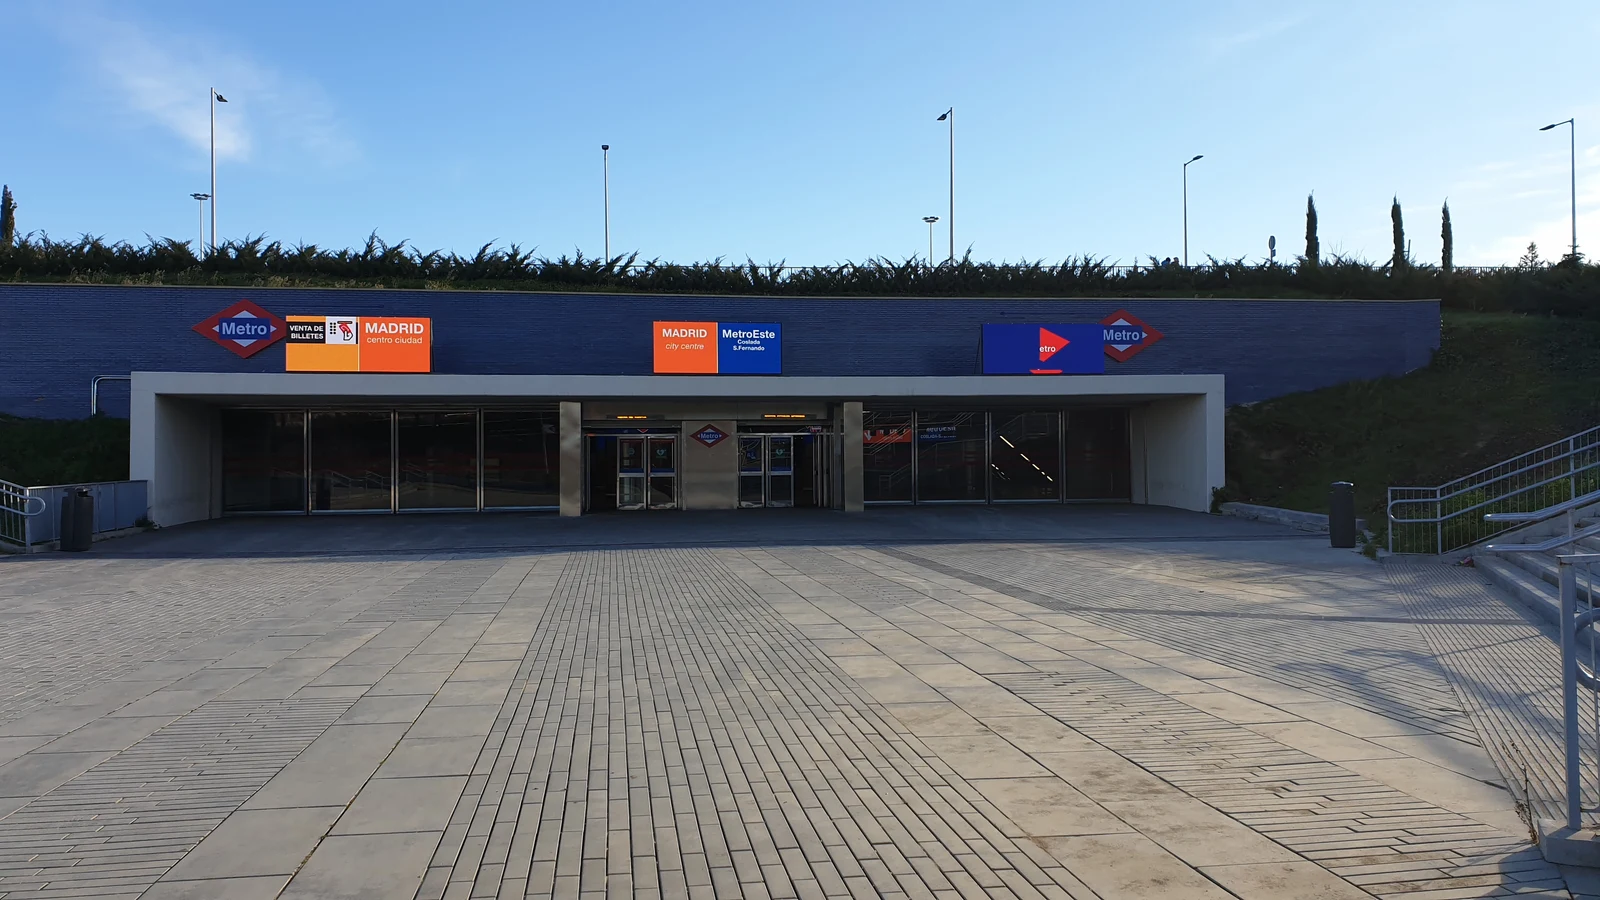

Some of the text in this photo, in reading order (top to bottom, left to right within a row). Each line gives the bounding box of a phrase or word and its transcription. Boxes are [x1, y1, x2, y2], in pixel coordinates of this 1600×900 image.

[222, 321, 267, 335] Metro
[365, 322, 424, 334] MADRID
[662, 328, 708, 338] MADRID
[722, 329, 775, 339] MetroEste
[1103, 329, 1139, 341] Metro
[367, 336, 423, 344] centro ciudad
[665, 342, 679, 350] city
[1039, 345, 1056, 353] etro
[700, 432, 719, 440] Metro
